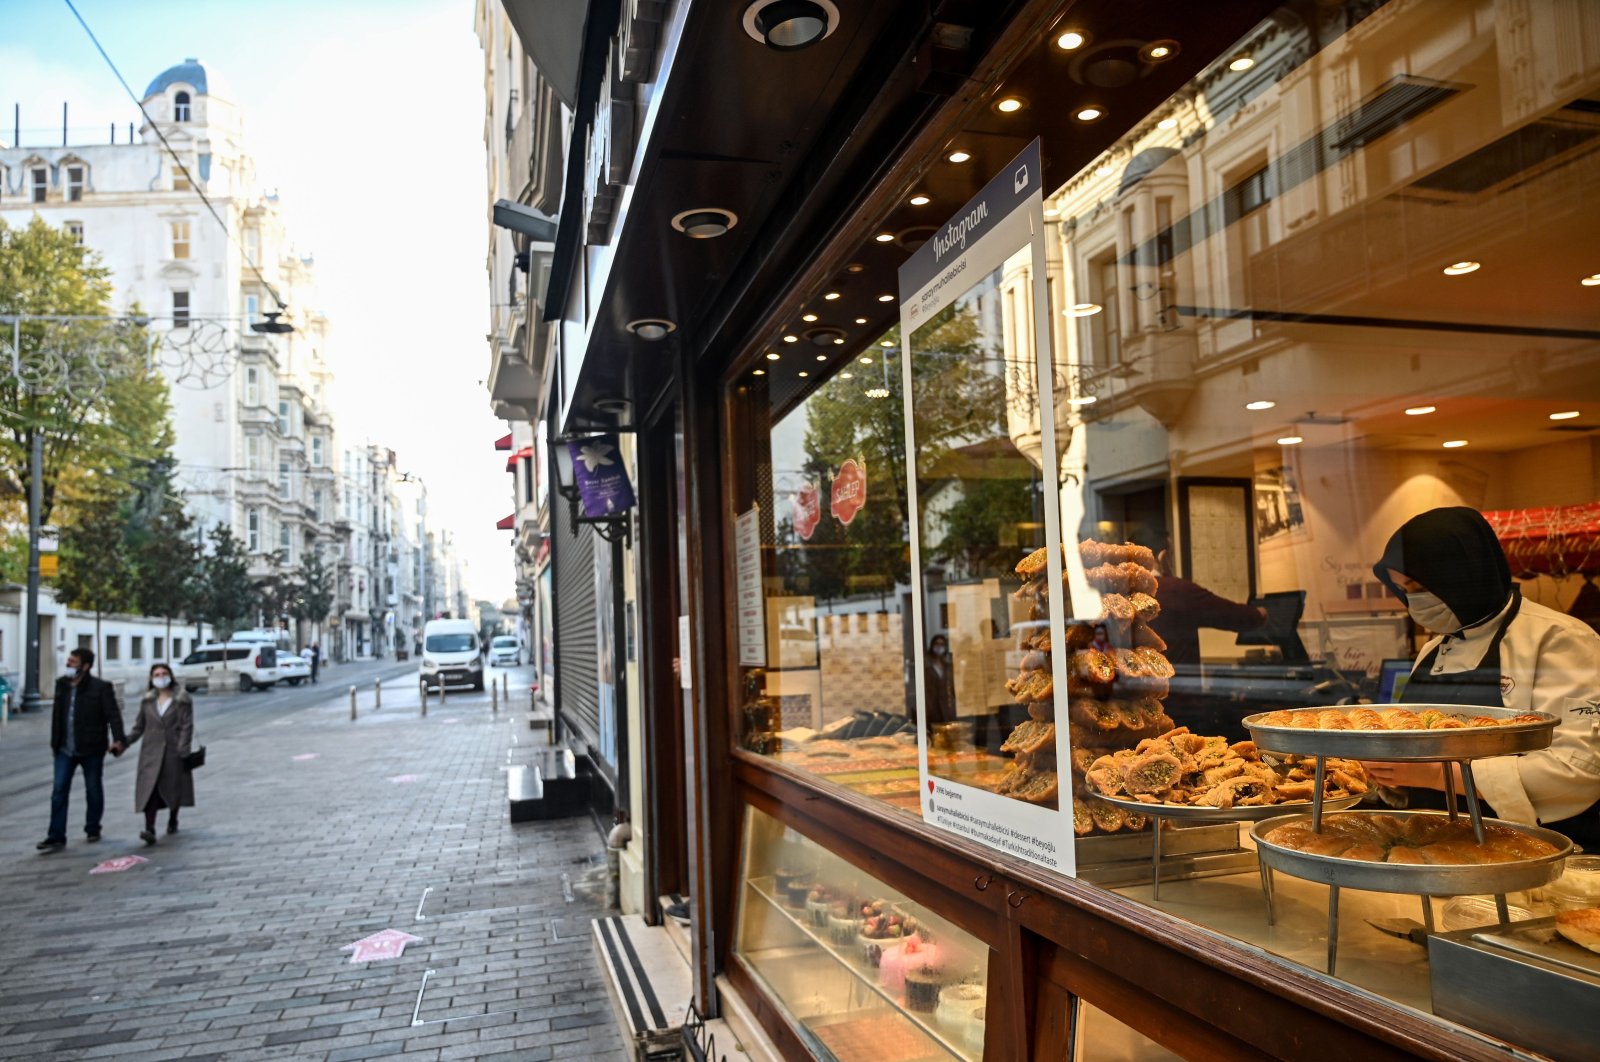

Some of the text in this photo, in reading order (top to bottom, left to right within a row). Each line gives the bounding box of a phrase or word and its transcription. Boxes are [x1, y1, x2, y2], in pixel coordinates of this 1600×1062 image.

[933, 200, 989, 263] Instagram
[1010, 828, 1031, 845] #dessert
[1031, 836, 1056, 854] #beyoğlu
